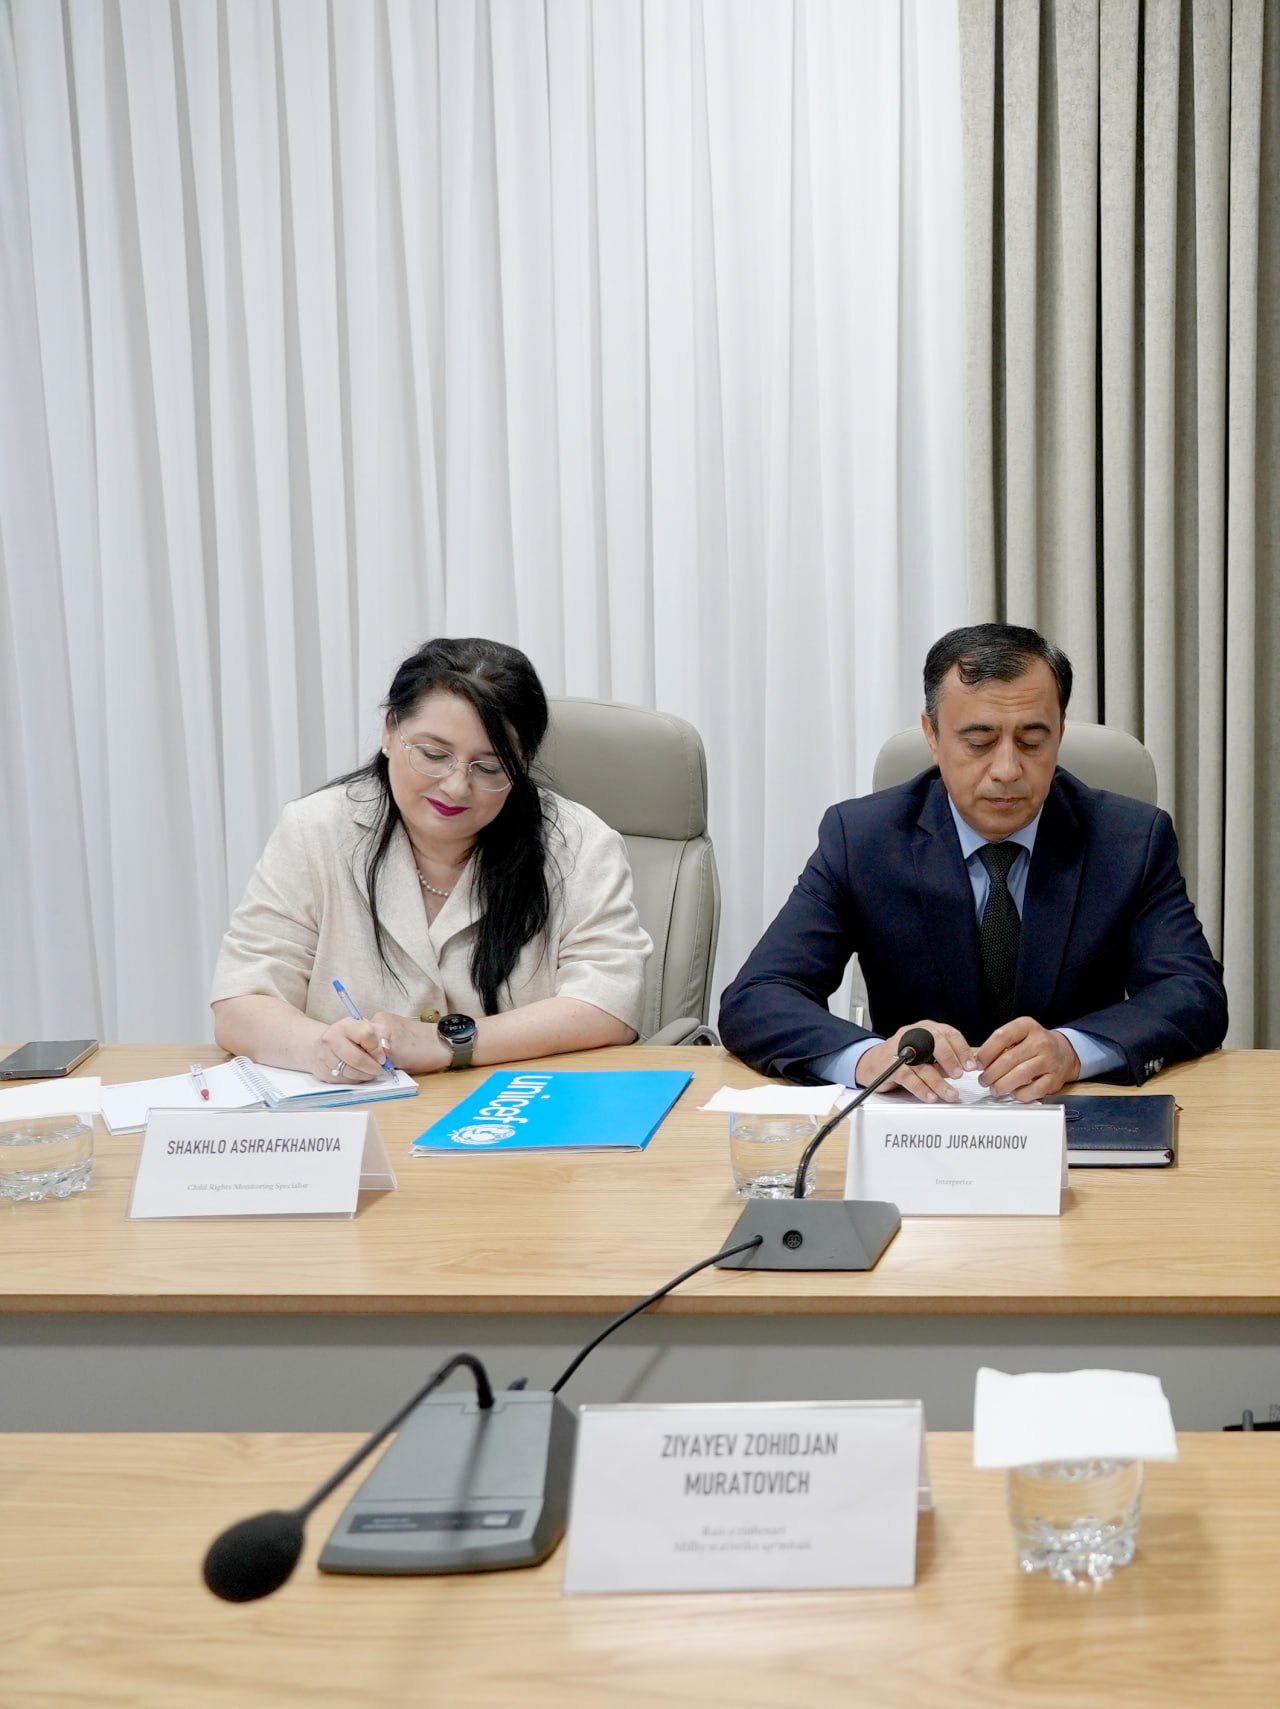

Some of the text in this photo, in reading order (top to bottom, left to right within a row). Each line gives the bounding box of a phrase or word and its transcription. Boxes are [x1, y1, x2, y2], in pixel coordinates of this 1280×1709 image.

[472, 1075, 553, 1125] unicef
[167, 1137, 341, 1155] SHAKHLO ASHRAFKHANOVA
[885, 1133, 1028, 1150] FARKHOD JURAKHONOV
[187, 1183, 207, 1191] Child
[209, 1183, 232, 1192] Rights
[661, 1432, 839, 1458] ZIYAYEV ZOHIDJAN
[684, 1470, 810, 1496] MURATOVICH
